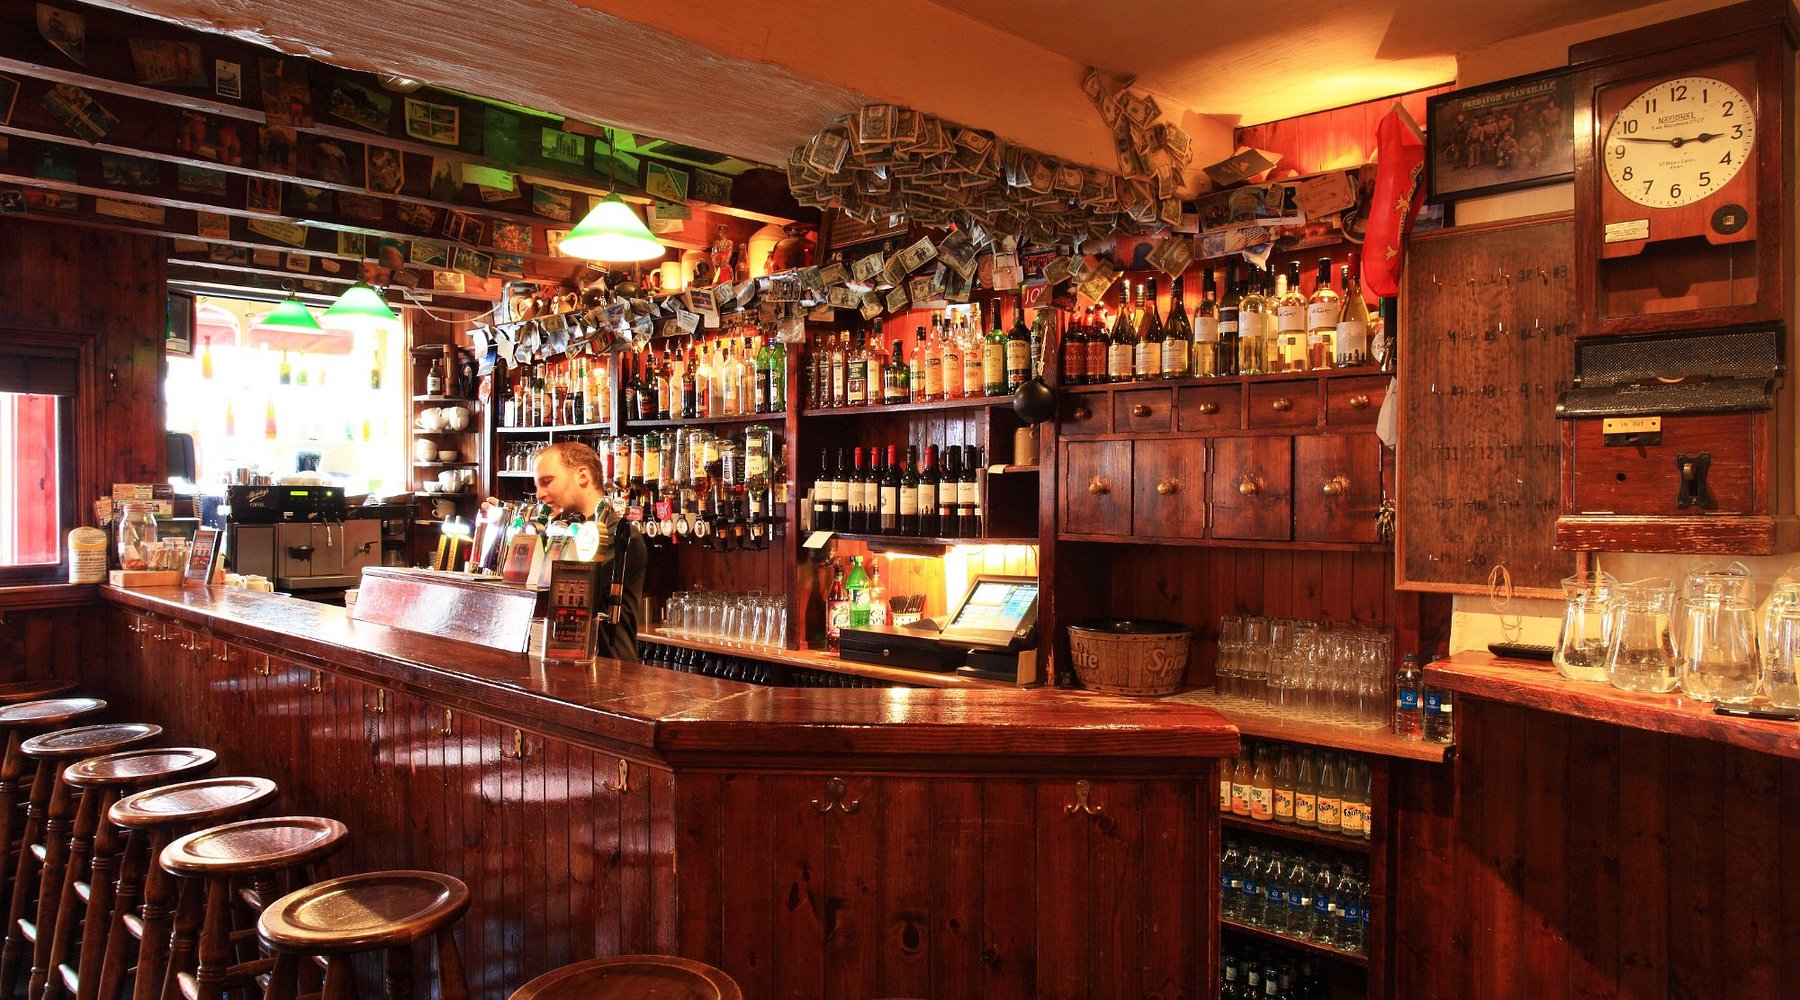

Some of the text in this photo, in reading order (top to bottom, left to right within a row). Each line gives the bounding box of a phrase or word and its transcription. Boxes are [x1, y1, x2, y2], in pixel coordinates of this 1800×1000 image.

[1670, 85, 1688, 102] 12
[1702, 88, 1708, 103] 1
[1645, 98, 1657, 114] 11
[1721, 101, 1734, 118] 2
[1658, 111, 1696, 125] NATIONAL
[1623, 119, 1638, 134] 10
[1731, 124, 1744, 139] 3
[1615, 145, 1626, 159] 9
[1719, 150, 1732, 165] 4
[1622, 166, 1634, 181] 8
[1699, 171, 1711, 187] 5
[1643, 179, 1654, 195] 7
[1670, 183, 1682, 198] 6
